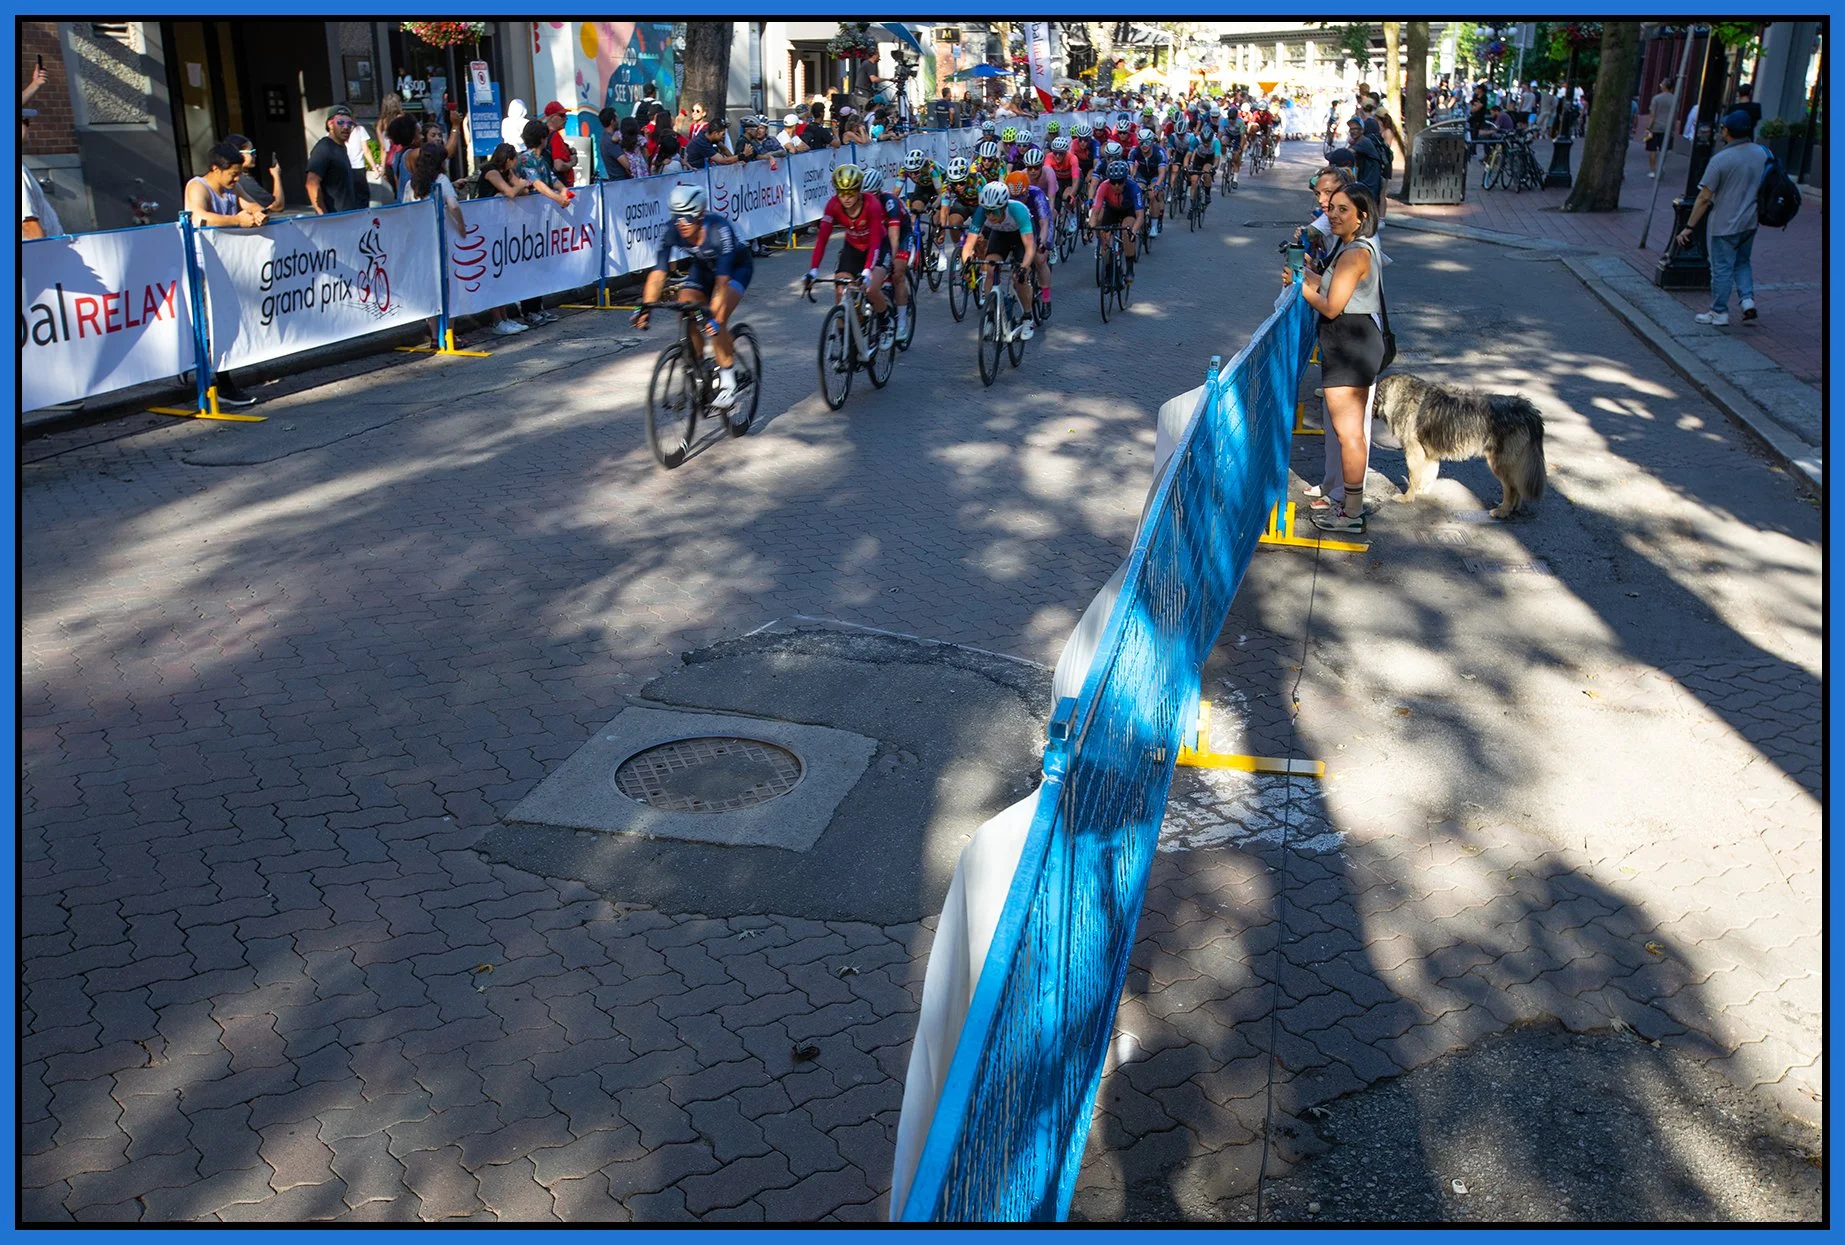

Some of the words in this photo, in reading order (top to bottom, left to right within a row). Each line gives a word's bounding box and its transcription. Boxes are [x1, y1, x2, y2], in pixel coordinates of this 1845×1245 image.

[1031, 22, 1044, 76] balRELAY
[615, 84, 627, 102] SEE
[473, 121, 491, 130] LOADING
[625, 199, 660, 226] gastown
[260, 248, 337, 291] gastown
[260, 282, 315, 326] grand
[321, 274, 353, 313] prix
